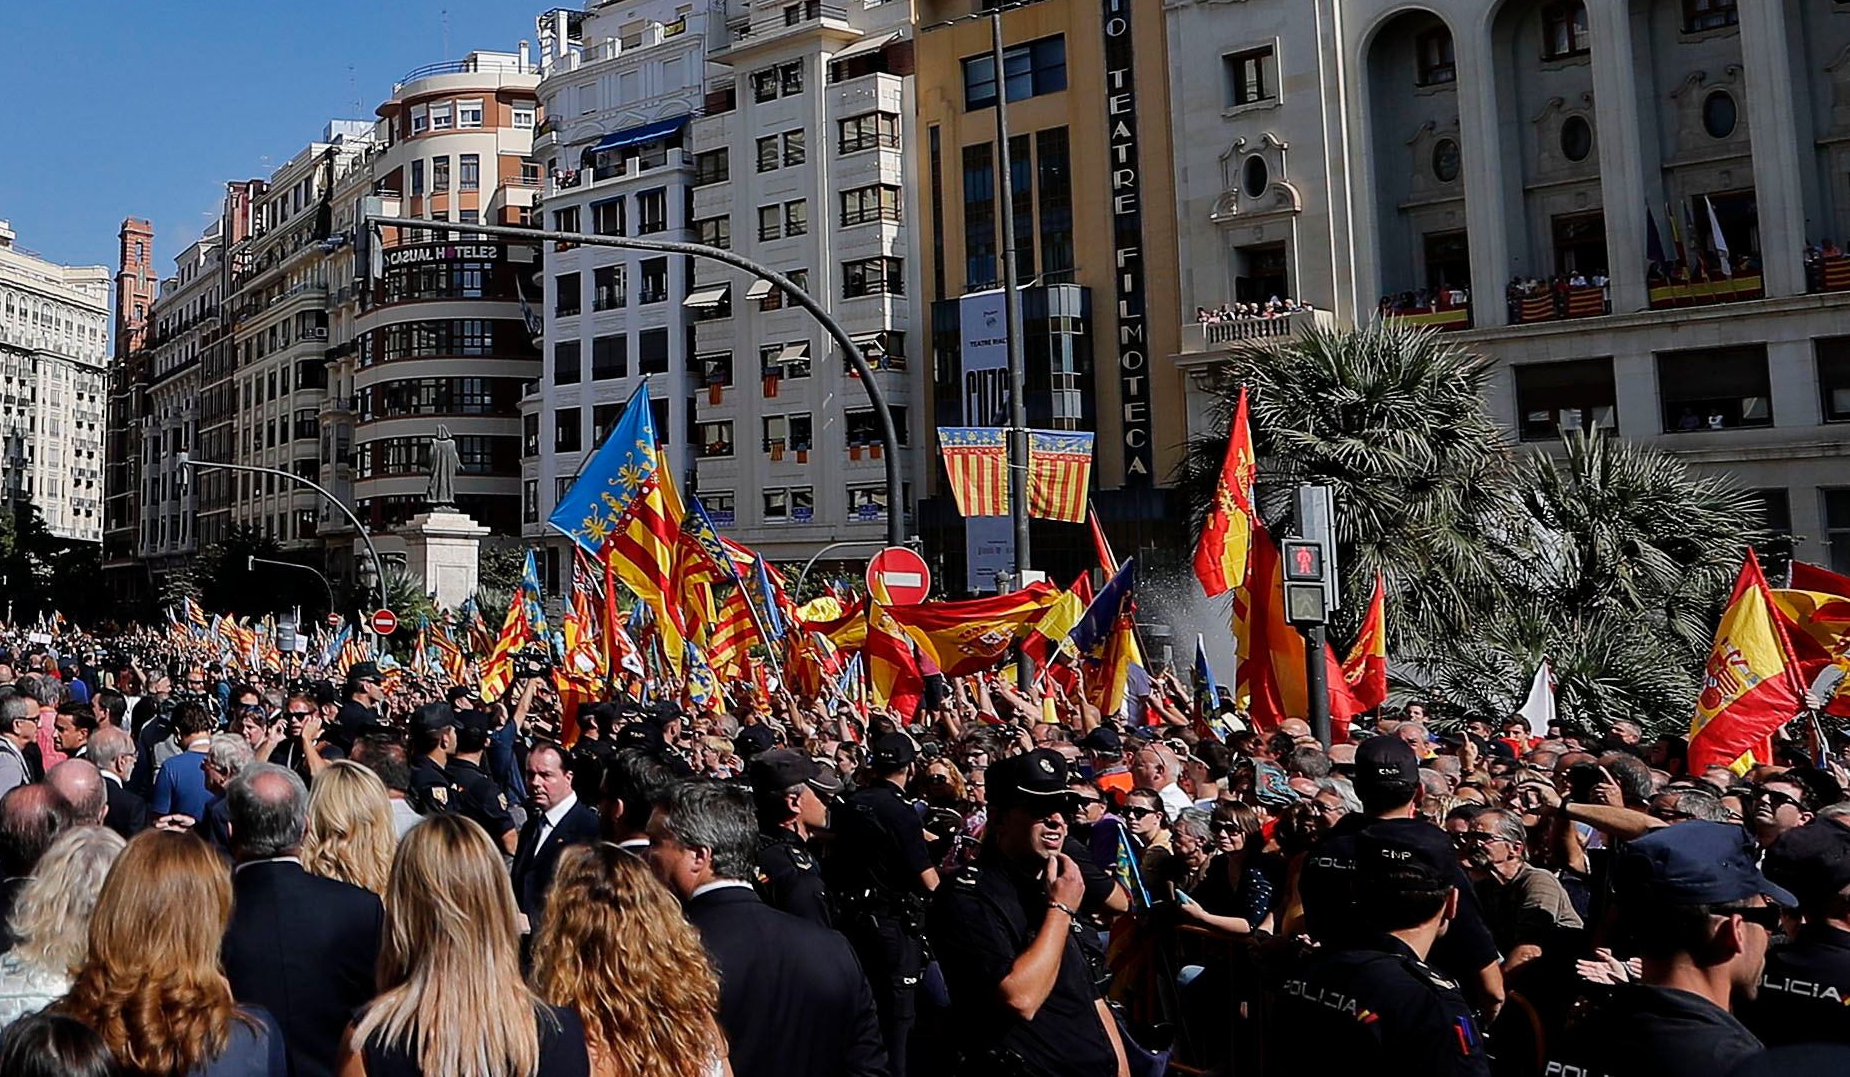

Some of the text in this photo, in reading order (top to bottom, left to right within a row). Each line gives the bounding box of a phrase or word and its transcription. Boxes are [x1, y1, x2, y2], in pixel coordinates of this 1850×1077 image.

[1108, 68, 1136, 215] TEATRE
[390, 248, 434, 264] CASUAL
[1116, 248, 1148, 475] FILMOTECA
[1381, 849, 1412, 860] CNP
